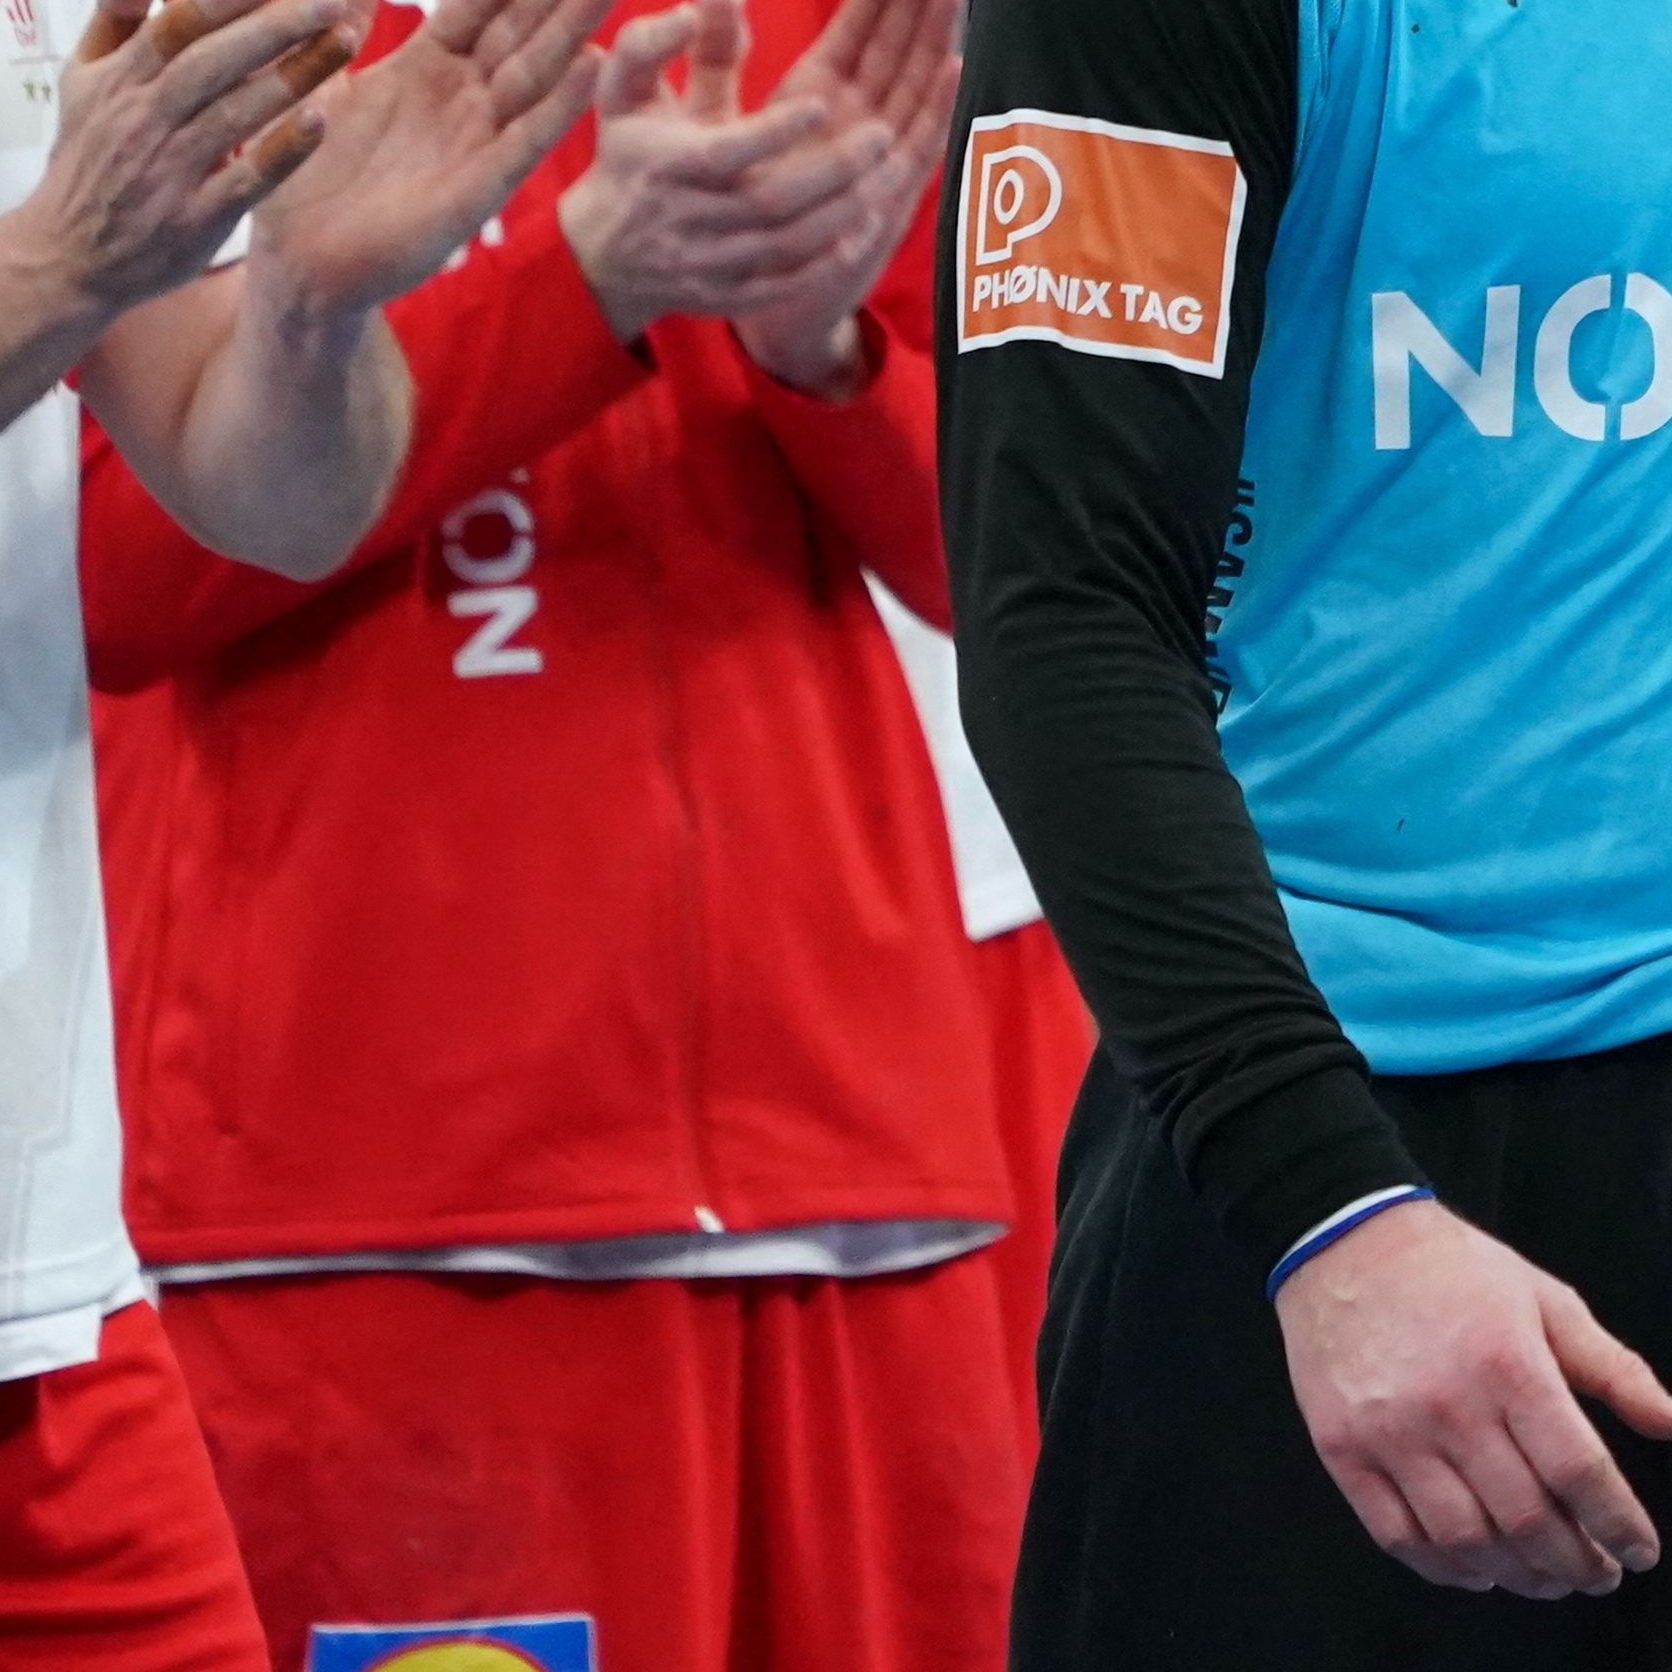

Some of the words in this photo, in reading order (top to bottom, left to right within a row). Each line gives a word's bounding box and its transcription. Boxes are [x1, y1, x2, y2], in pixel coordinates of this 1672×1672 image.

[973, 265, 1113, 319] PHØNIX
[1120, 284, 1204, 335] TAG
[443, 470, 544, 679] NO
